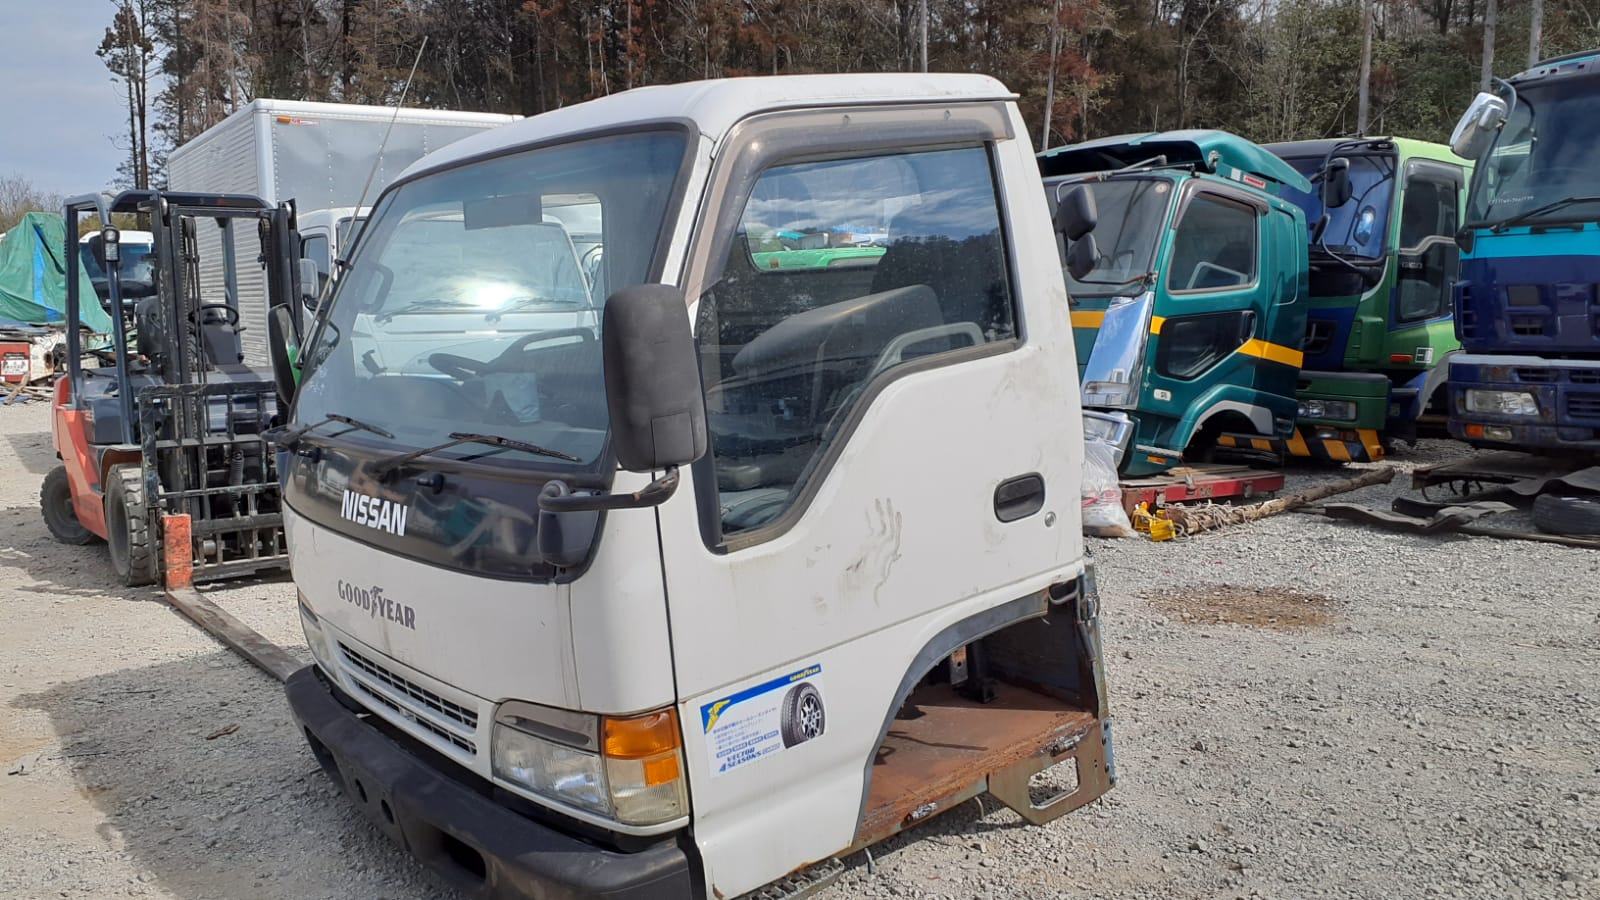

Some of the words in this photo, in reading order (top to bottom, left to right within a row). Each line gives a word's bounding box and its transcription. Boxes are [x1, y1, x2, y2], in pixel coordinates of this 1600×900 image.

[340, 489, 408, 537] NISSAN
[337, 579, 416, 630] GOODYEAR
[727, 747, 756, 762] VECTOR
[727, 751, 762, 768] SEASONS
